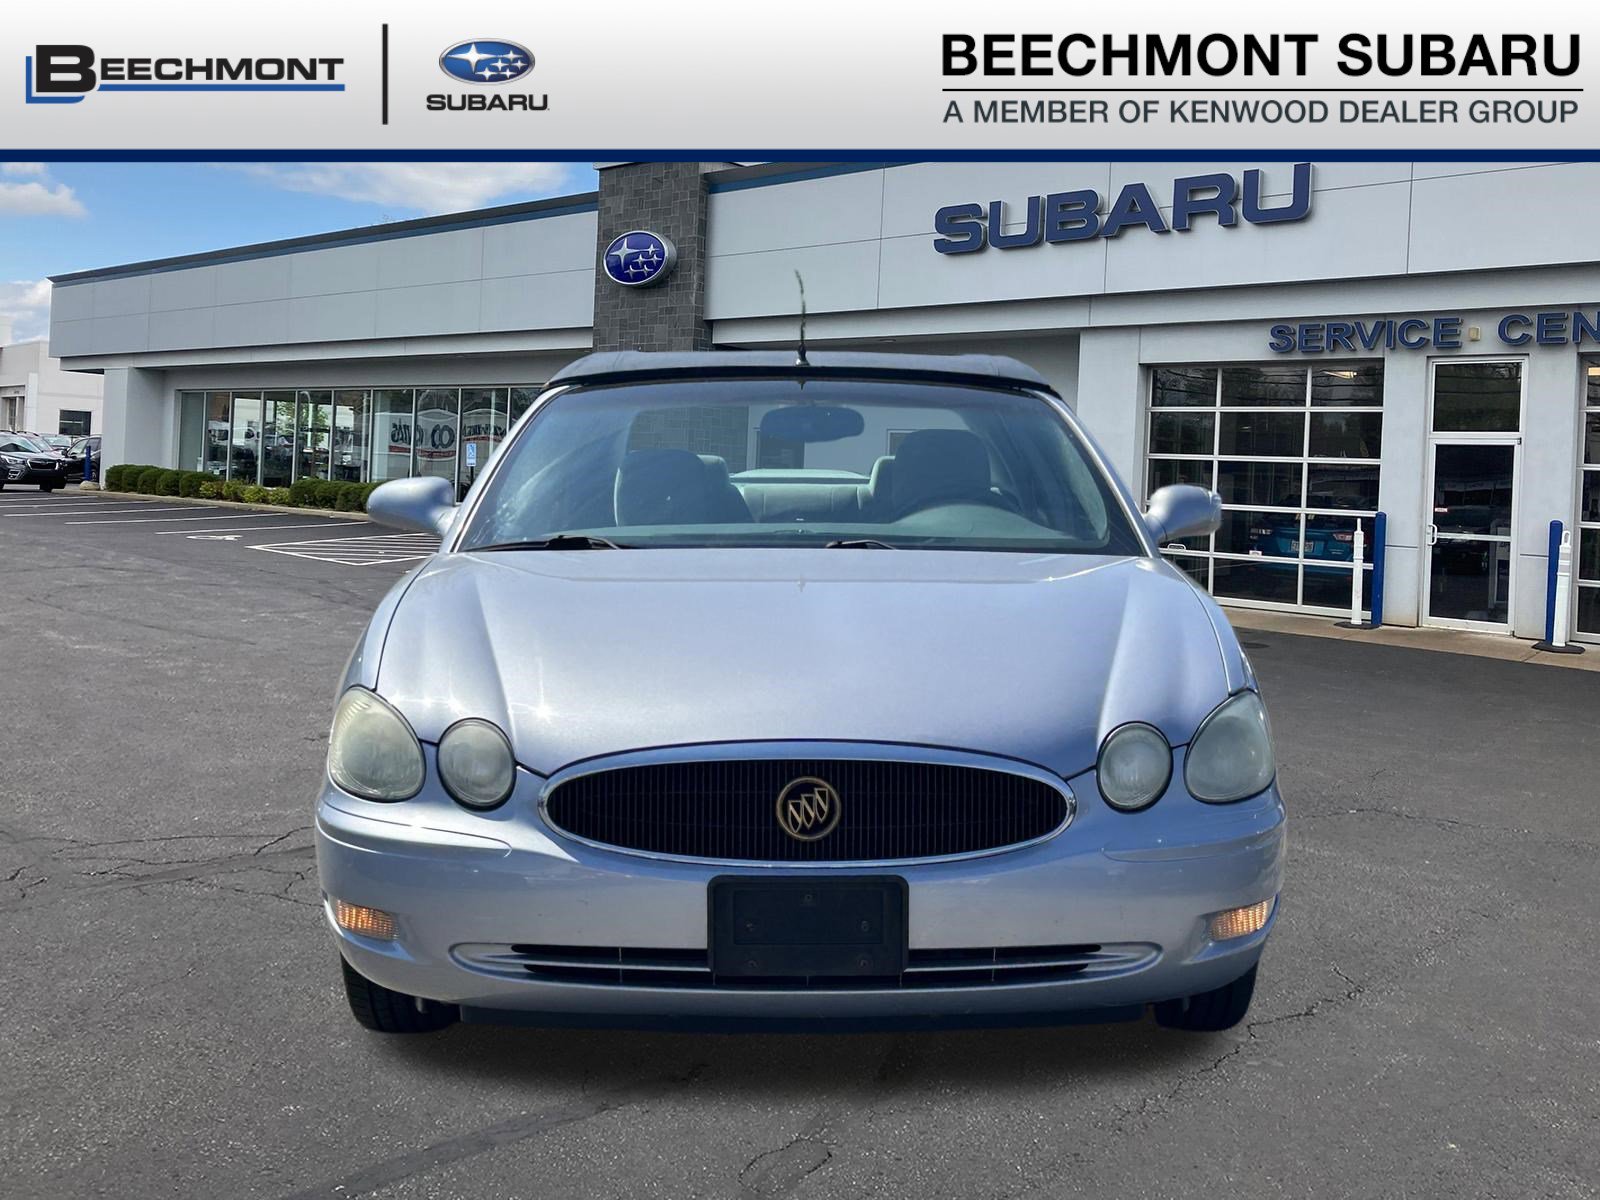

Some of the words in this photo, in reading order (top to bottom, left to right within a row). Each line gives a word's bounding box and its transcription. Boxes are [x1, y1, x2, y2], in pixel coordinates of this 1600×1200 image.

[933, 162, 1312, 254] SUBARU
[1269, 317, 1463, 353] SERVICE
[1497, 310, 1600, 346] CEN
